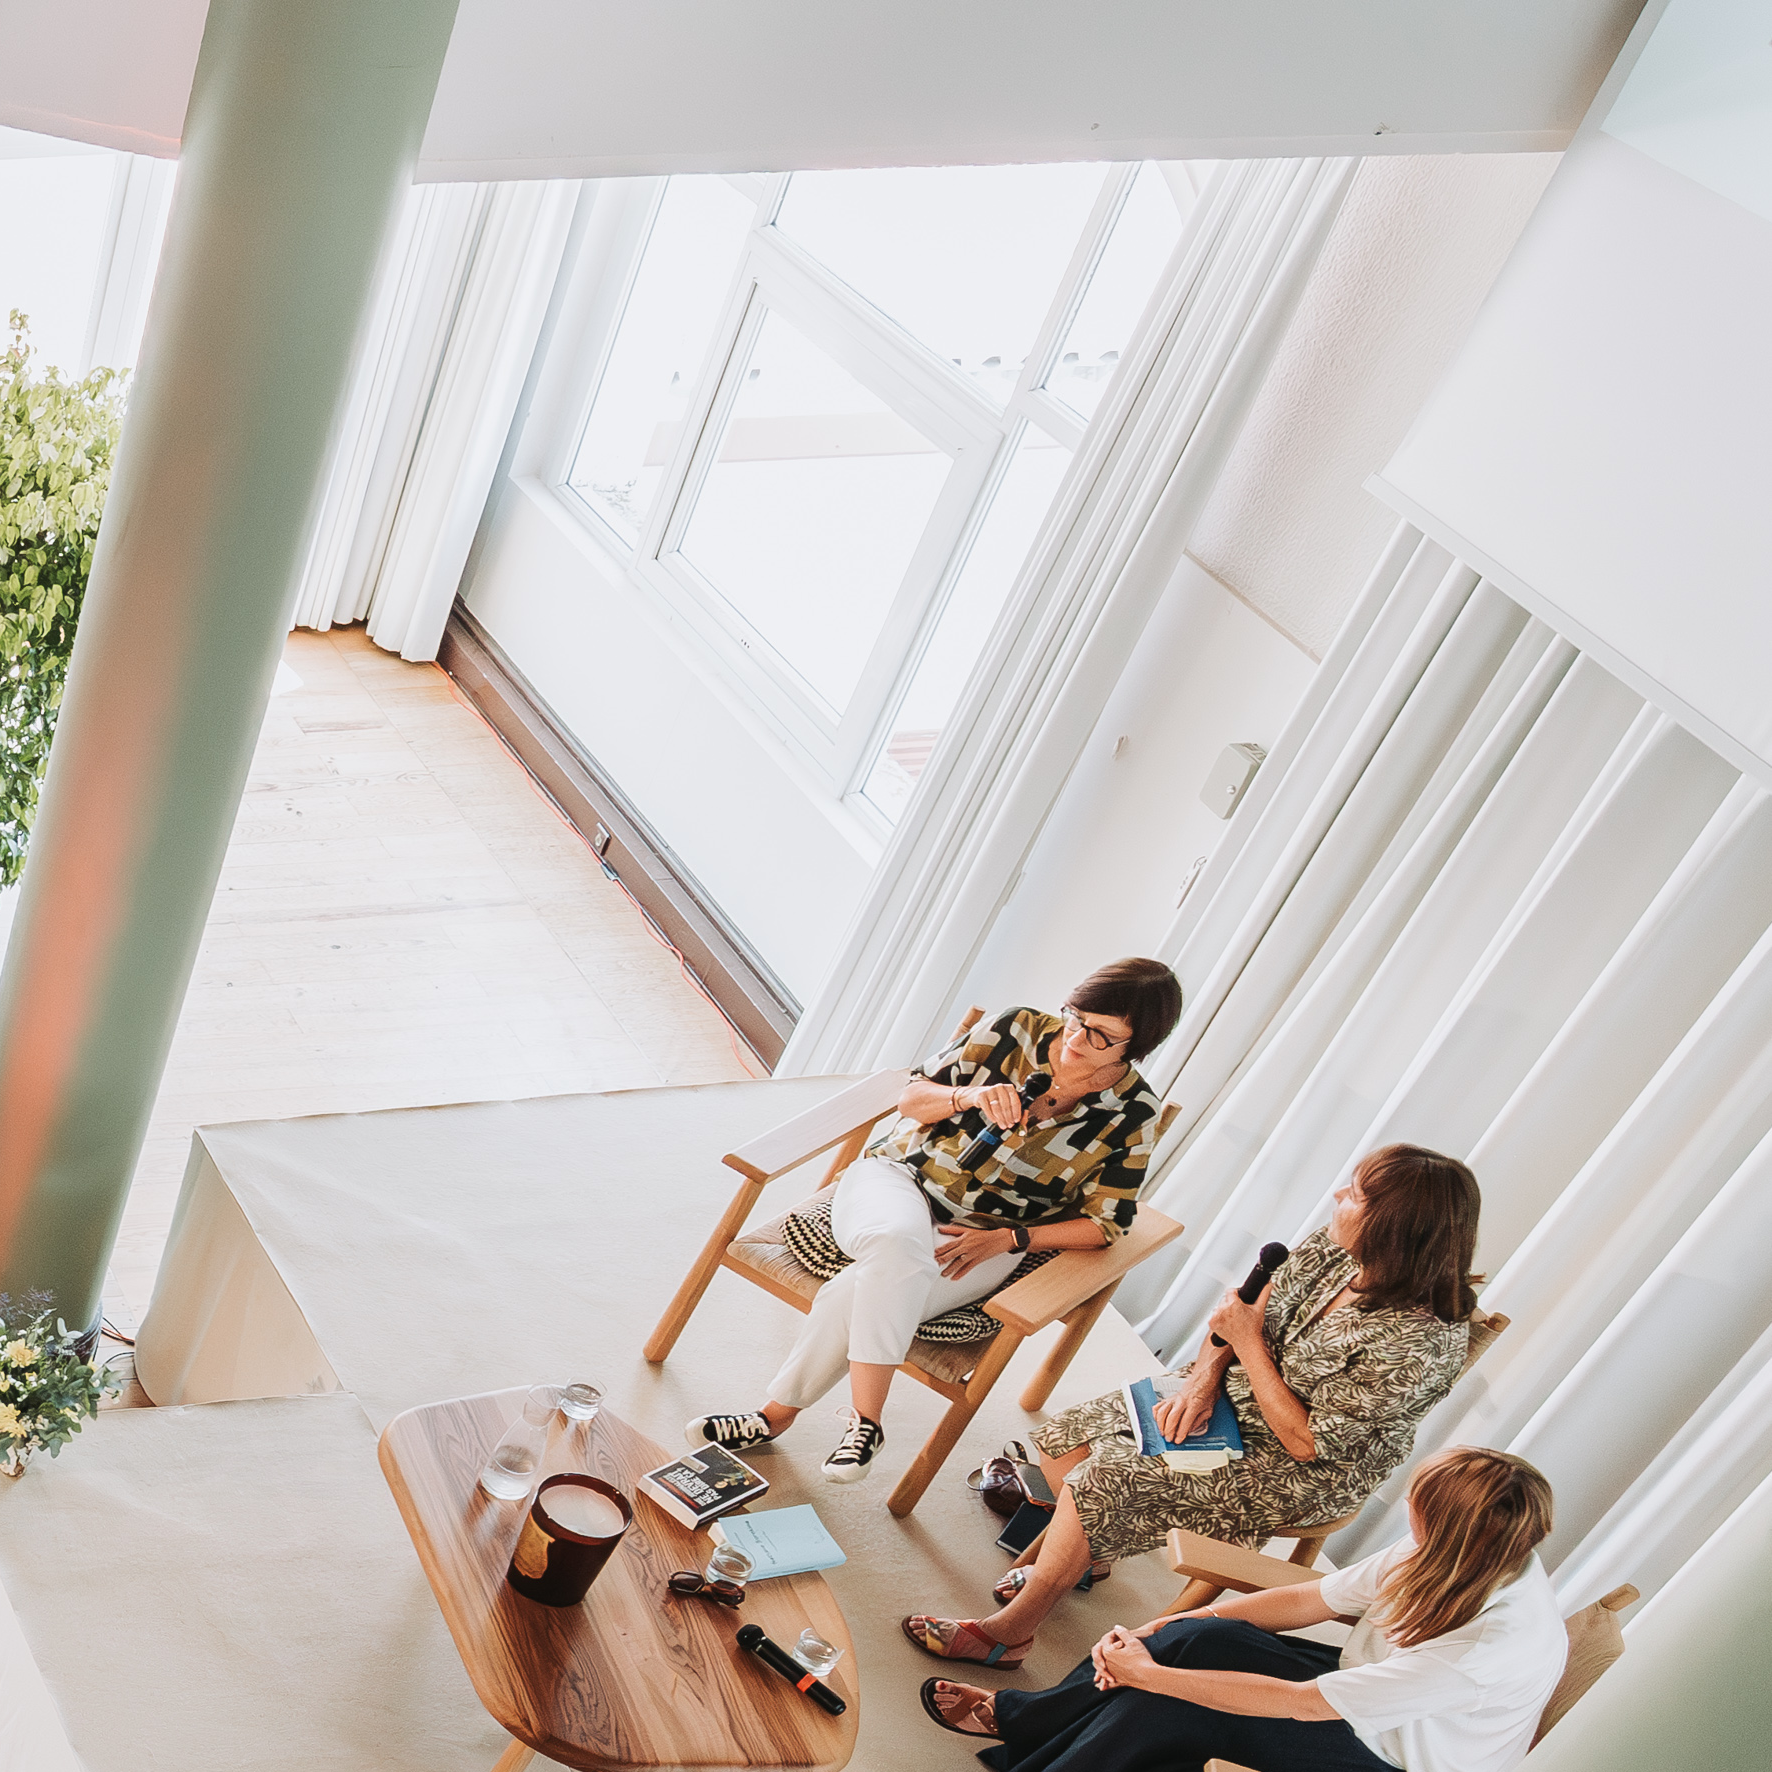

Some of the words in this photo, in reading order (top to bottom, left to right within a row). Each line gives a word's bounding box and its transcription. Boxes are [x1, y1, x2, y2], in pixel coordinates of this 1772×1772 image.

[671, 1470, 704, 1495] DEVRAIT
[691, 1476, 710, 1491] DIRE
[699, 1493, 714, 1504] NE
[706, 1488, 722, 1501] PAS
